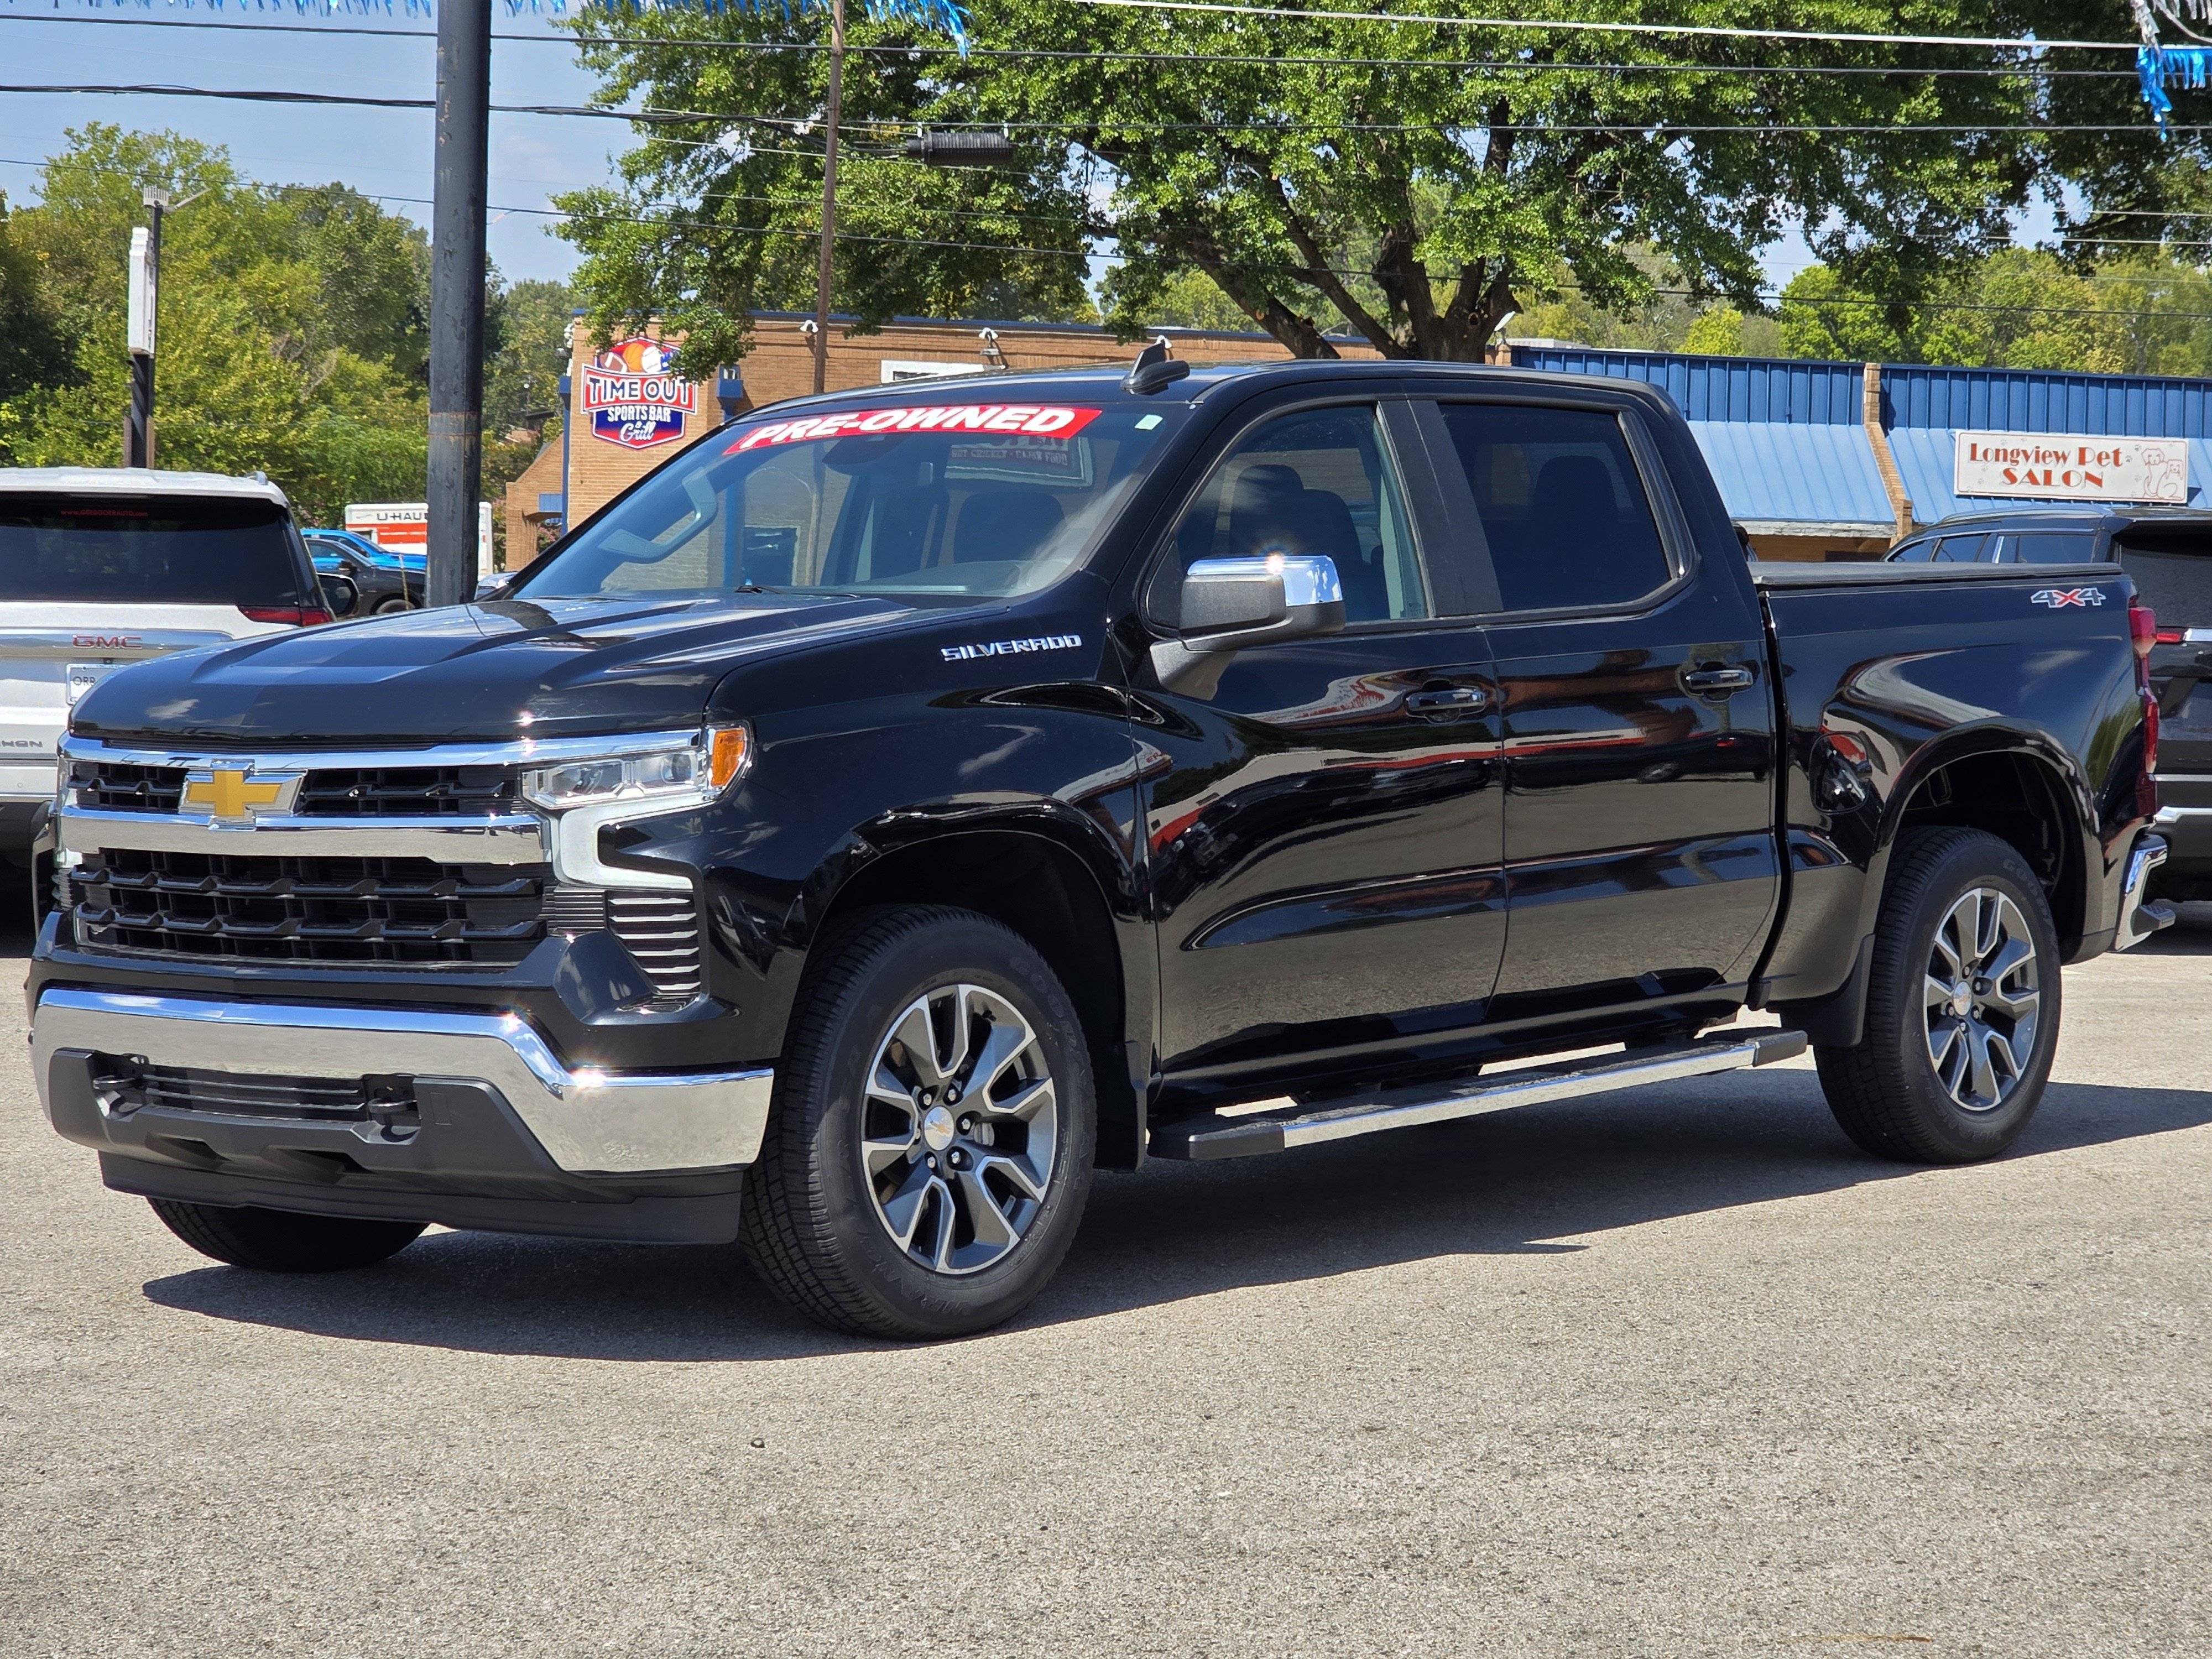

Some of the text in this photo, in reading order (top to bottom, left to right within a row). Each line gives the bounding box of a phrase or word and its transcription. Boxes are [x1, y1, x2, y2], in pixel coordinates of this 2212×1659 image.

[587, 374, 690, 405] TIME OUT
[607, 405, 671, 422] SPORTS BAR
[620, 421, 656, 442] Grill
[739, 407, 1074, 448] PRE-OWNED
[1045, 452, 1068, 466] FOOD
[1970, 443, 2122, 467] Longview Pet
[2002, 467, 2103, 488] SALON
[72, 635, 143, 649] GMC
[941, 635, 1082, 661] SILVERADO
